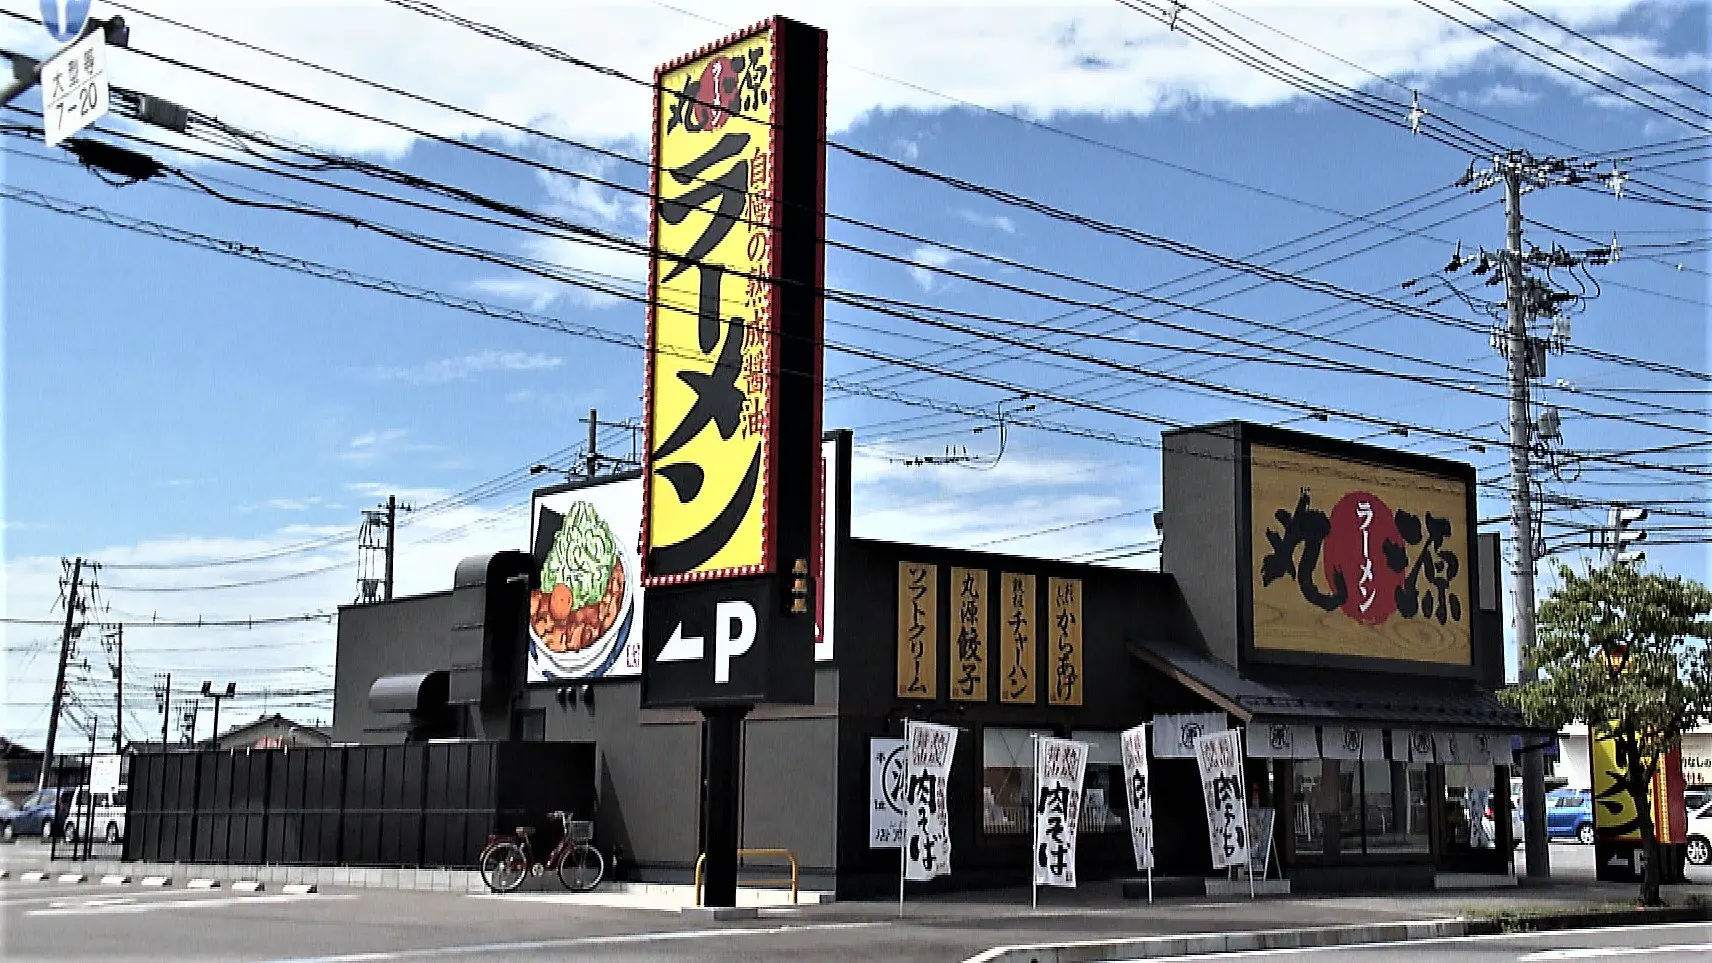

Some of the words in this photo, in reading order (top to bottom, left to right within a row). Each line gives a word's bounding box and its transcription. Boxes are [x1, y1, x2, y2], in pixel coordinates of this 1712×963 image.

[55, 82, 98, 132] 7-20
[648, 132, 764, 577] ラーメン
[1356, 501, 1377, 613] ラーメン
[714, 600, 758, 684] P
[907, 568, 928, 694] ソフトクリーム
[907, 767, 942, 871] 肉そば
[1038, 780, 1071, 876] 肉そば
